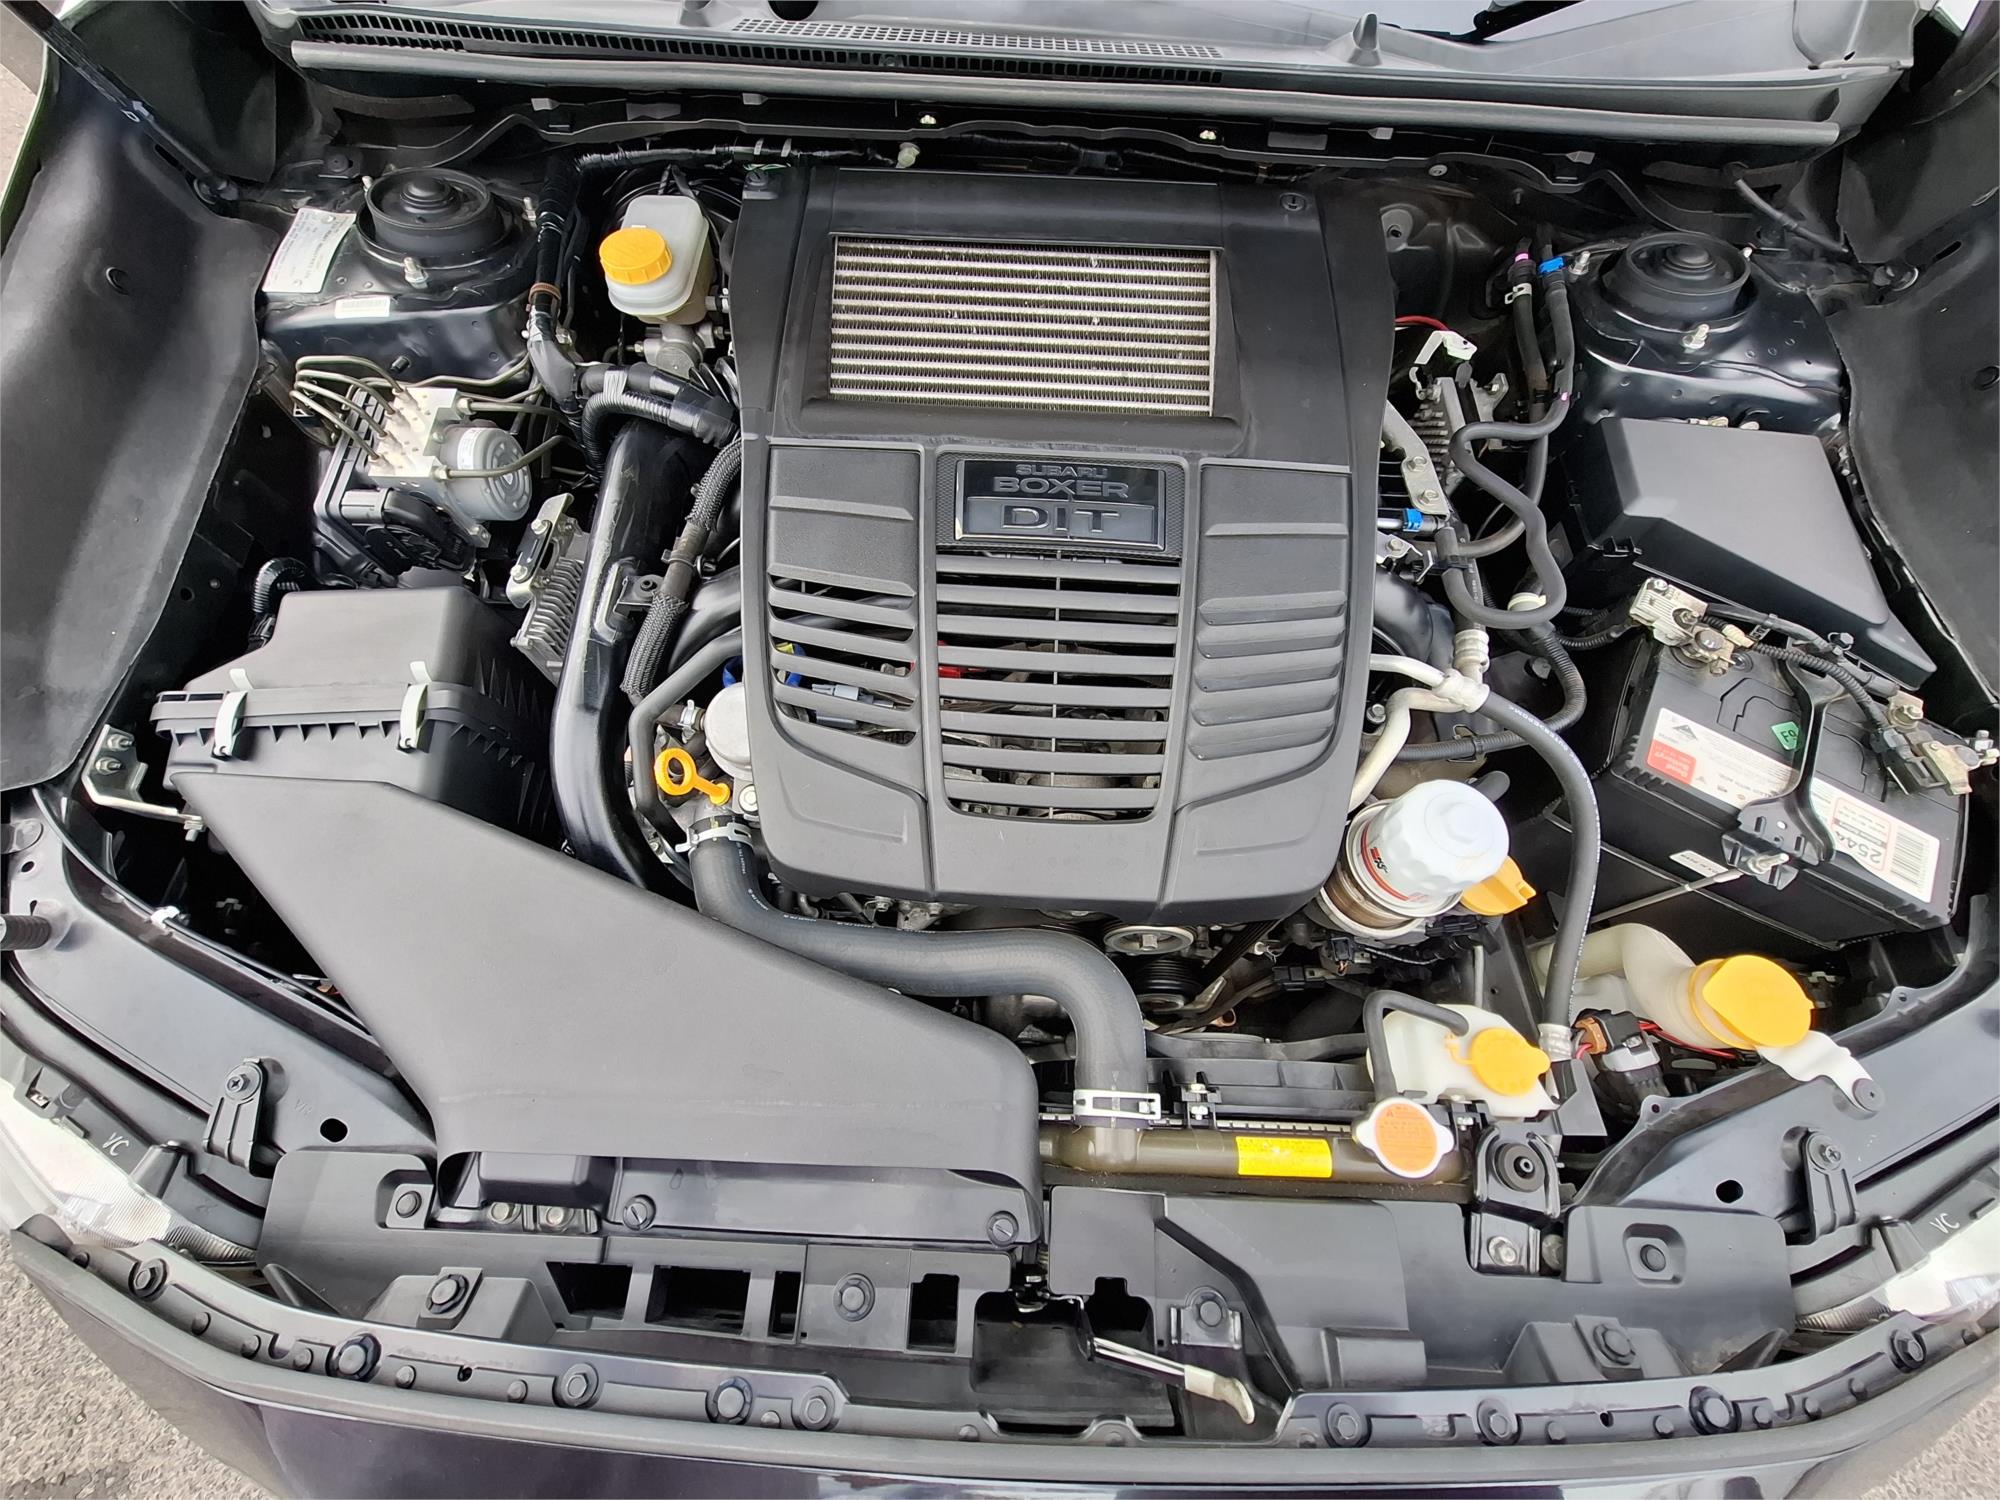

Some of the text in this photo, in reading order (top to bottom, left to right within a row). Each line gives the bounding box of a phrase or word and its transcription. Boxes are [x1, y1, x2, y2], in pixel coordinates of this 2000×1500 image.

[1015, 464, 1108, 479] SUBARU
[993, 476, 1129, 498] BOXER
[1001, 504, 1120, 533] DIT
[102, 1132, 130, 1156] VC
[1928, 1213, 1960, 1234] VC
